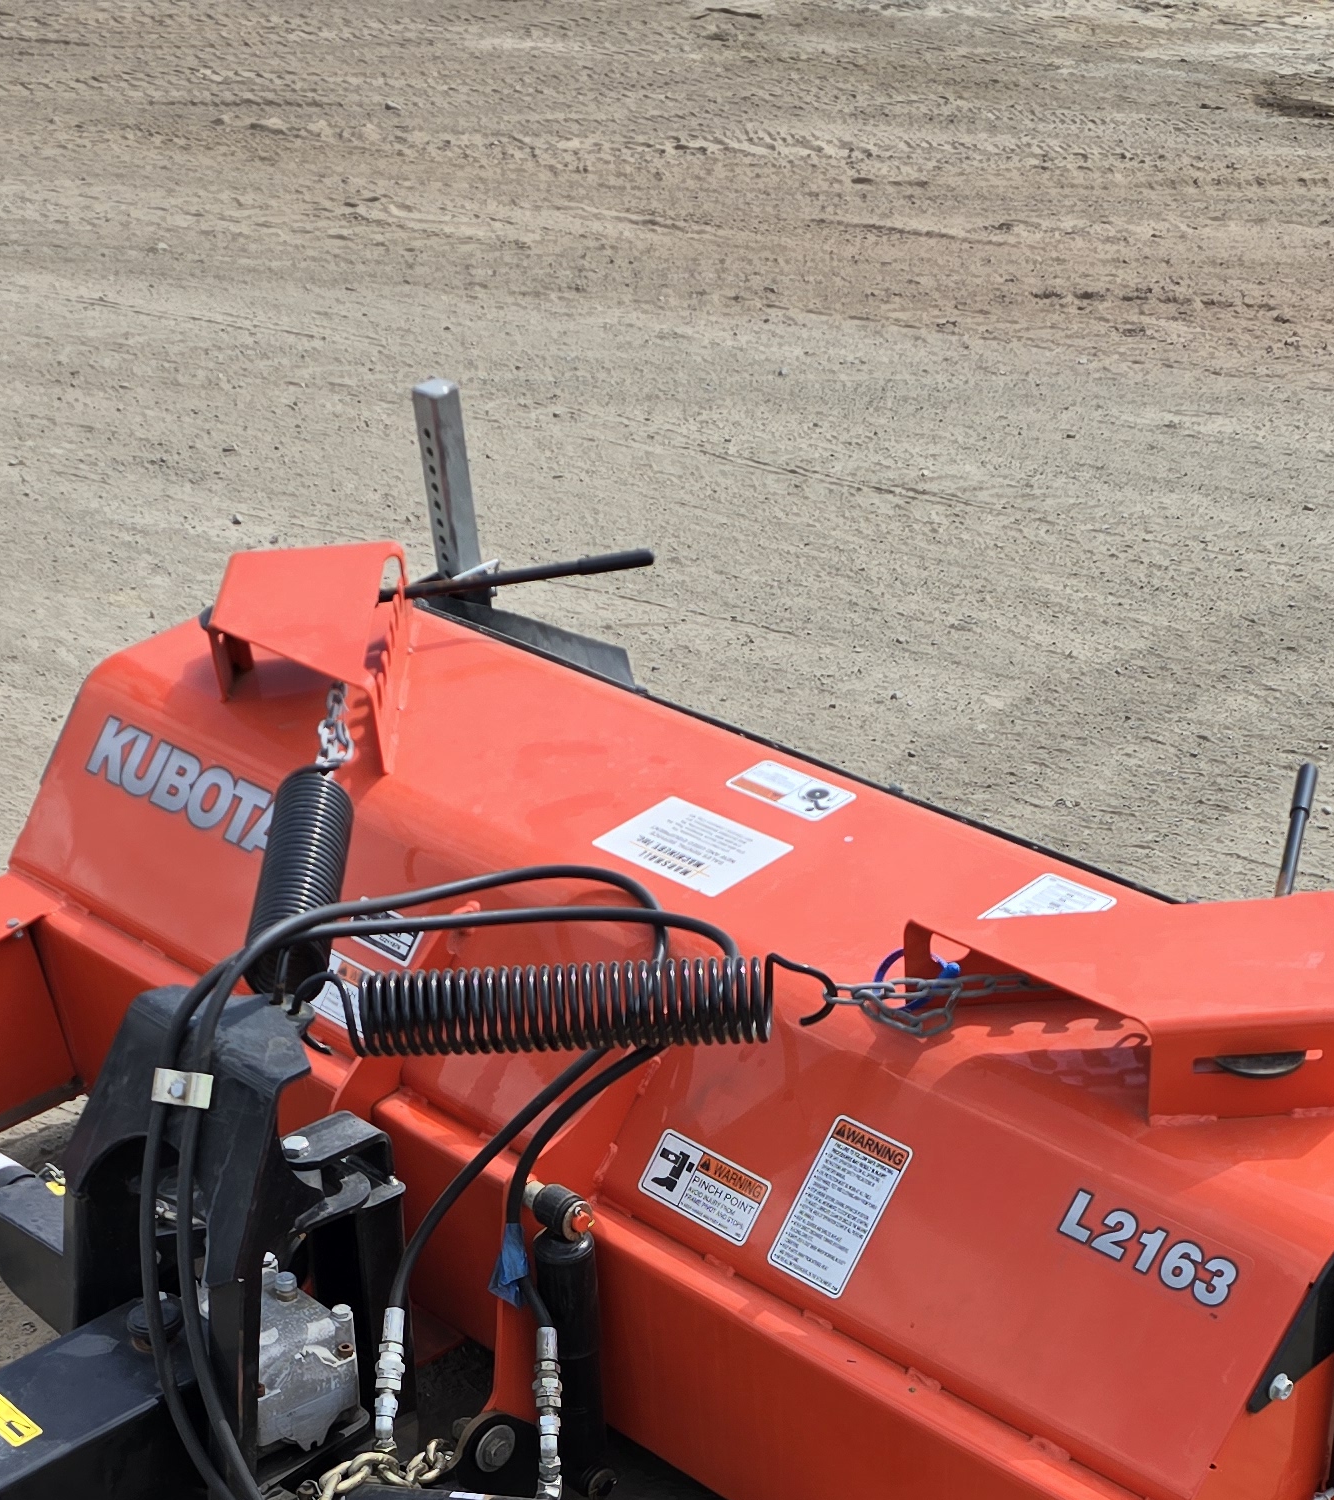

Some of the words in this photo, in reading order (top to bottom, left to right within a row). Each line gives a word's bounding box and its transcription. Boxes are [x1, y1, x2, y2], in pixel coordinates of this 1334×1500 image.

[638, 850, 692, 876] MARSHALL
[845, 1128, 904, 1166] WARNING
[692, 1176, 723, 1198] PINCH
[724, 1193, 755, 1215] POINT
[714, 1164, 763, 1199] WARNING
[1057, 1187, 1239, 1308] L2163
